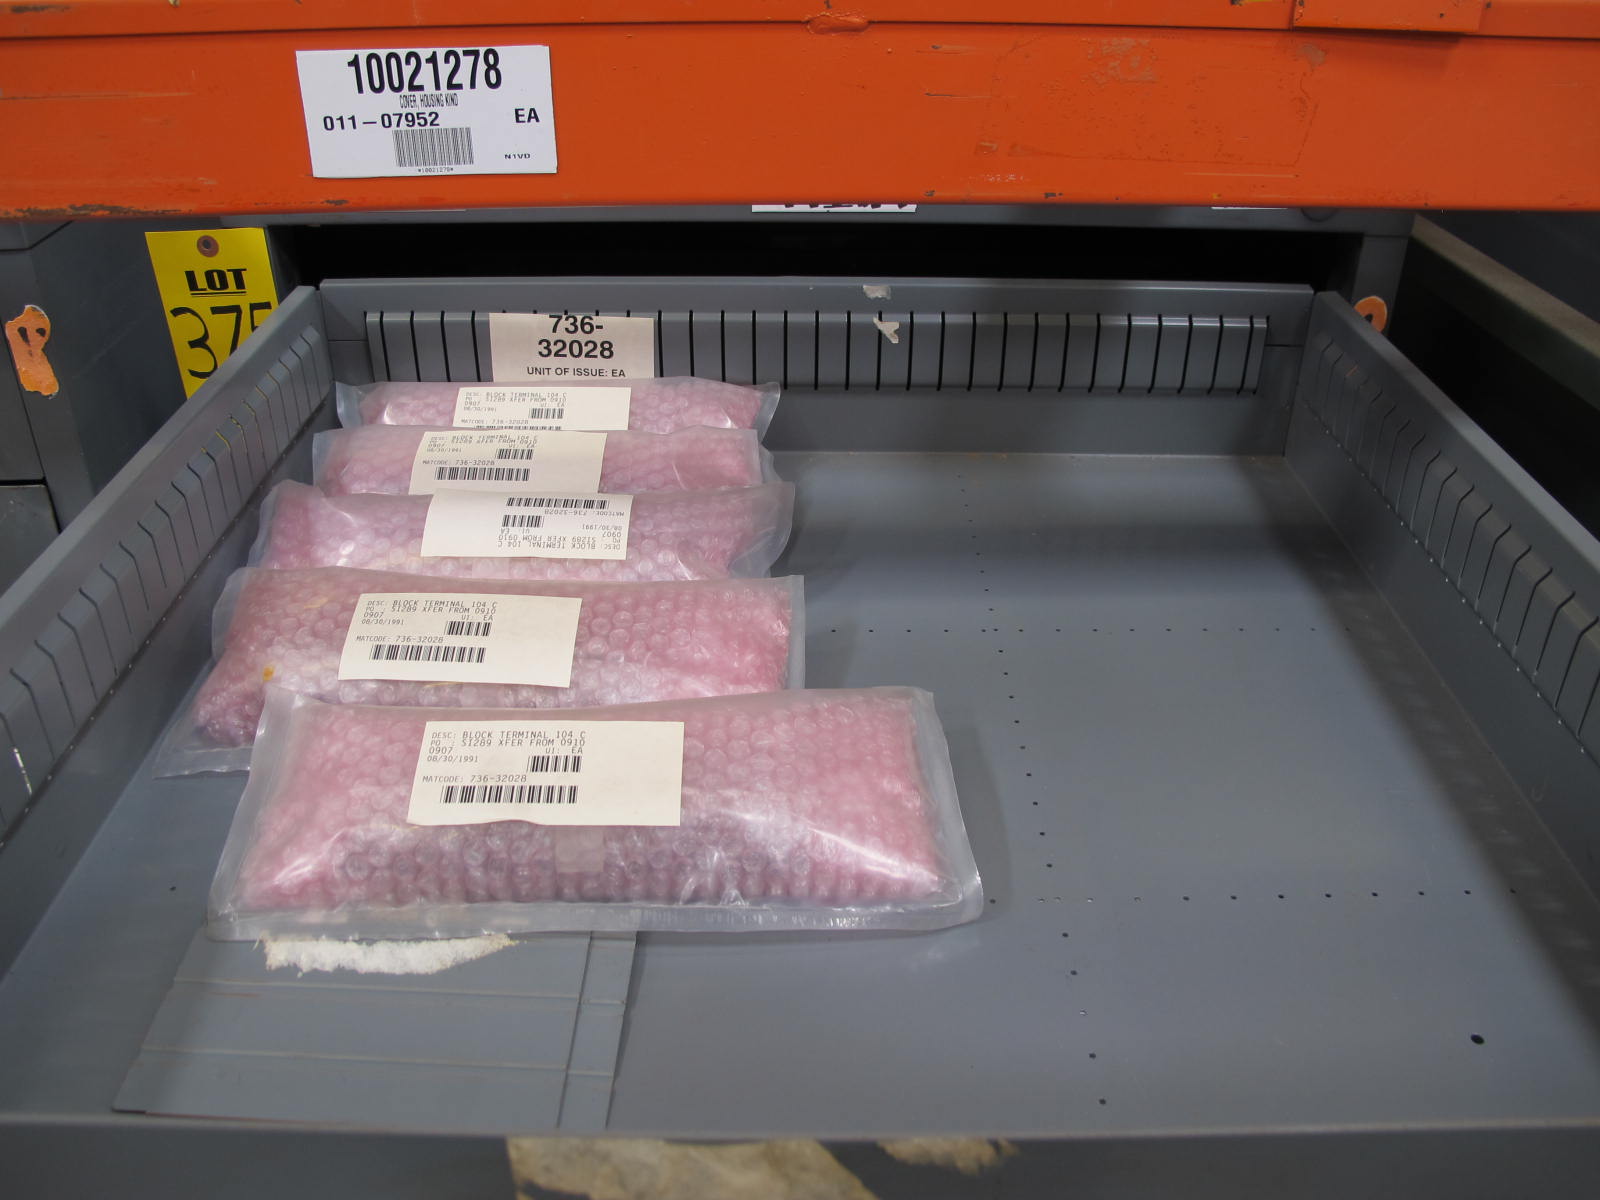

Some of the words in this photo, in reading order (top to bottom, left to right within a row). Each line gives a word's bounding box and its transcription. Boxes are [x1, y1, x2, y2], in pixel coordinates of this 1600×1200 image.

[347, 48, 502, 94] 10021278
[399, 94, 419, 109] COVER,
[420, 94, 444, 107] HOUSING
[445, 93, 458, 106] KIND
[514, 108, 540, 123] EA
[184, 268, 247, 292] LOT
[549, 314, 604, 334] 736-
[538, 338, 614, 359] 32028
[527, 366, 552, 375] UNIT
[555, 367, 569, 376] OF
[573, 368, 608, 377] ISSUE:
[611, 369, 626, 378] EA
[528, 541, 566, 549] TERMINAL
[475, 607, 497, 615] 0910
[431, 731, 457, 739] DESC:
[462, 730, 493, 739] BLOCK
[500, 730, 548, 739] TERMINAL
[556, 730, 573, 739] 104
[498, 738, 523, 747] XFER
[530, 738, 554, 747] FROM
[560, 738, 585, 747] 0910
[428, 746, 453, 755] 0907
[571, 746, 583, 754] EA
[427, 755, 479, 763] 08/30/1991
[422, 775, 464, 783] MATCODE:
[470, 774, 527, 783] 736-32028
